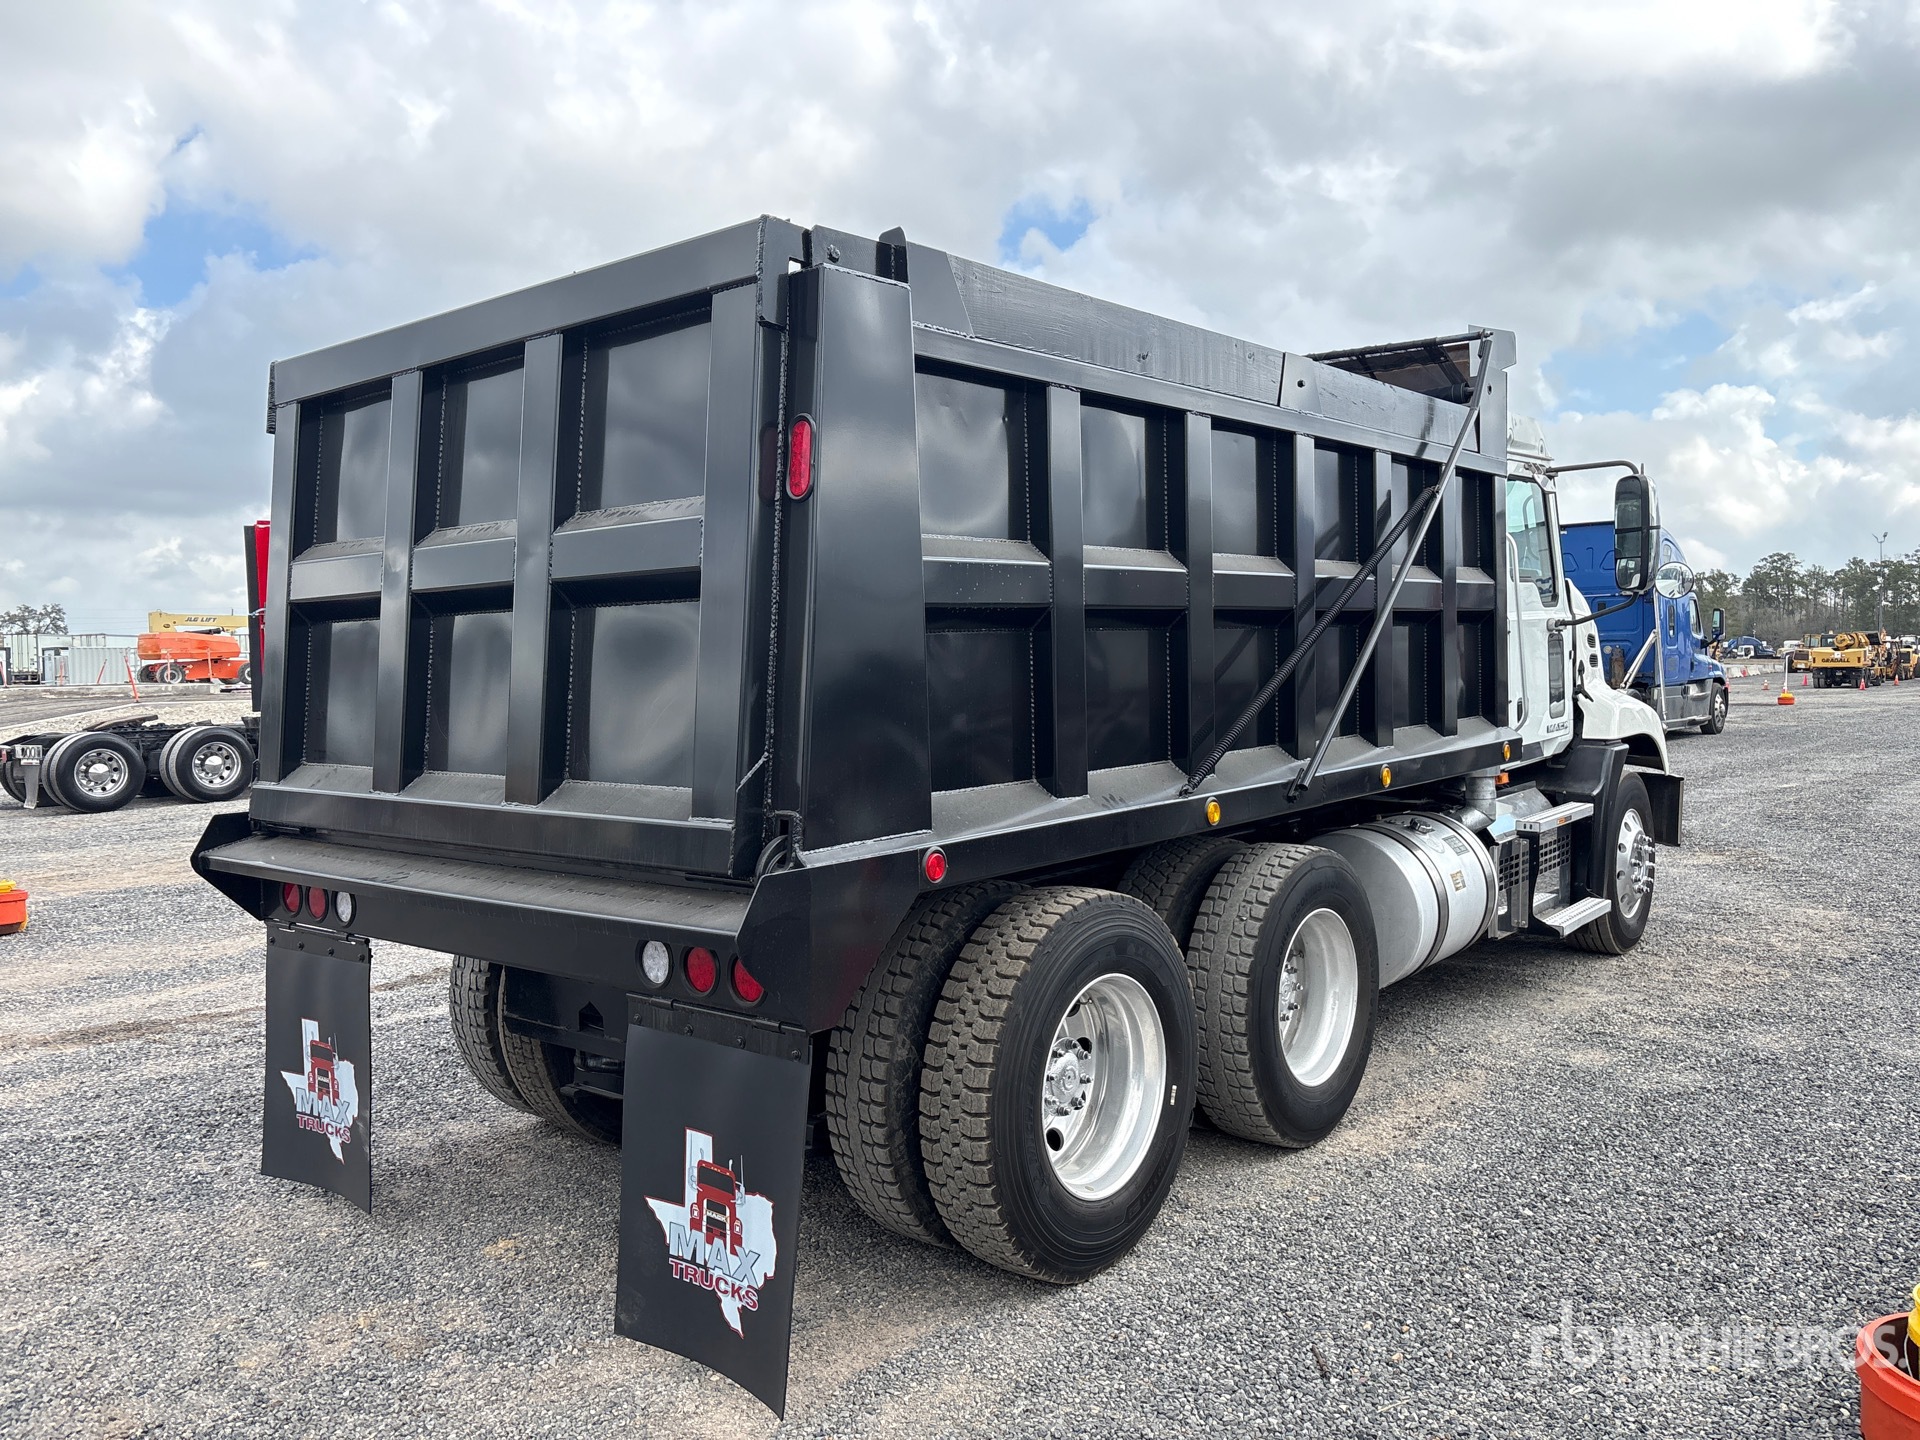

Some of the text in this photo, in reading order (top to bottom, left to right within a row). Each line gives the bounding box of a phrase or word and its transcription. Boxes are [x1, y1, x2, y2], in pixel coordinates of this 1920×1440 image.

[295, 1086, 350, 1127] MAX
[296, 1113, 351, 1144] TRUCKS
[669, 1221, 761, 1290] MAX
[668, 1258, 759, 1312] TRUCKS
